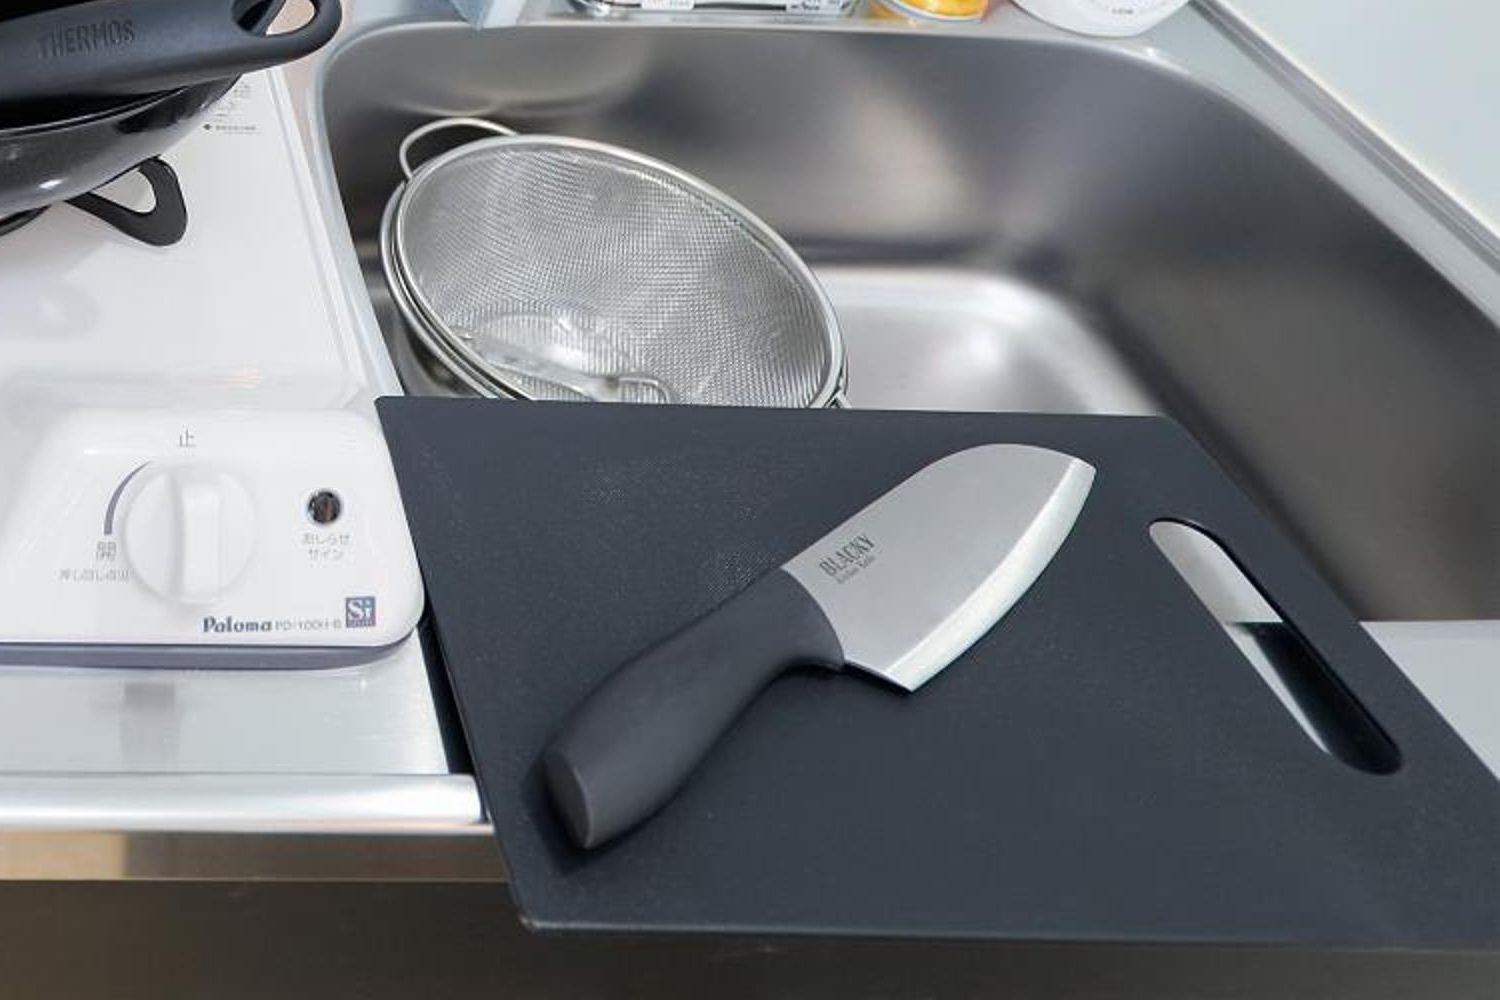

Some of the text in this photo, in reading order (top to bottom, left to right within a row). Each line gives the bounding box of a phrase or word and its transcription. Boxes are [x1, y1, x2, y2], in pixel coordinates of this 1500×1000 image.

[37, 19, 135, 59] THERMOS
[819, 534, 875, 577] BLACKY
[203, 616, 272, 633] Paloma
